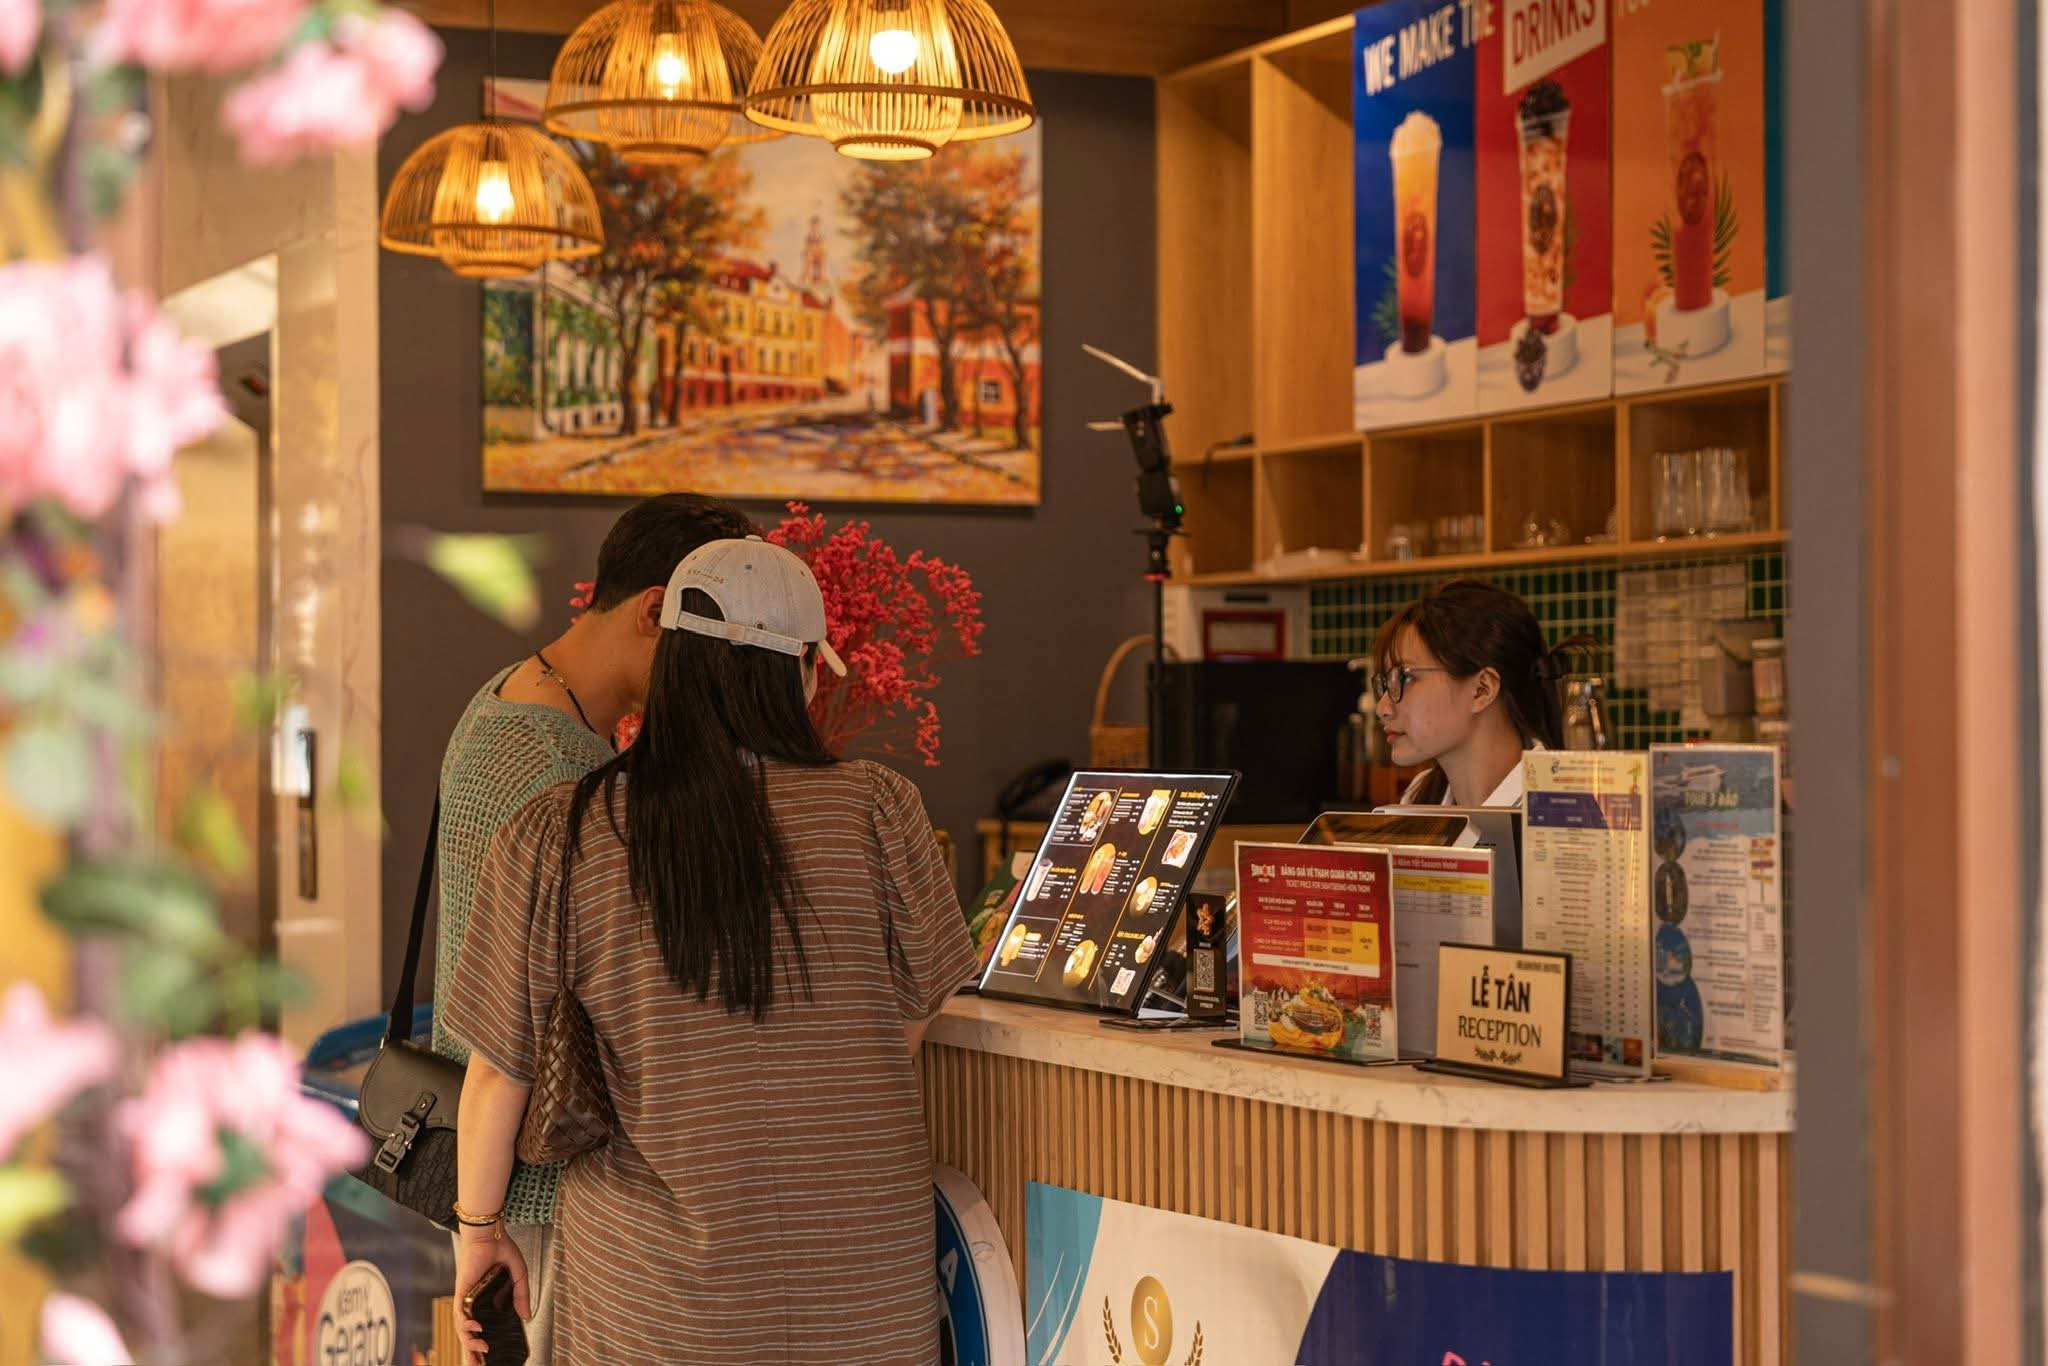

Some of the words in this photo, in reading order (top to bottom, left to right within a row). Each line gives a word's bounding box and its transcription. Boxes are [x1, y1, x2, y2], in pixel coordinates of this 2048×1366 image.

[1363, 33, 1396, 96] WE
[1399, 5, 1455, 80] MAKE
[1459, 0, 1495, 48] THE
[1511, 0, 1597, 66] DRINKS
[1494, 973, 1530, 1014] TÂN
[1458, 1015, 1542, 1048] RECEPTION
[319, 1311, 390, 1366] Gelato
[1143, 1295, 1160, 1350] S
